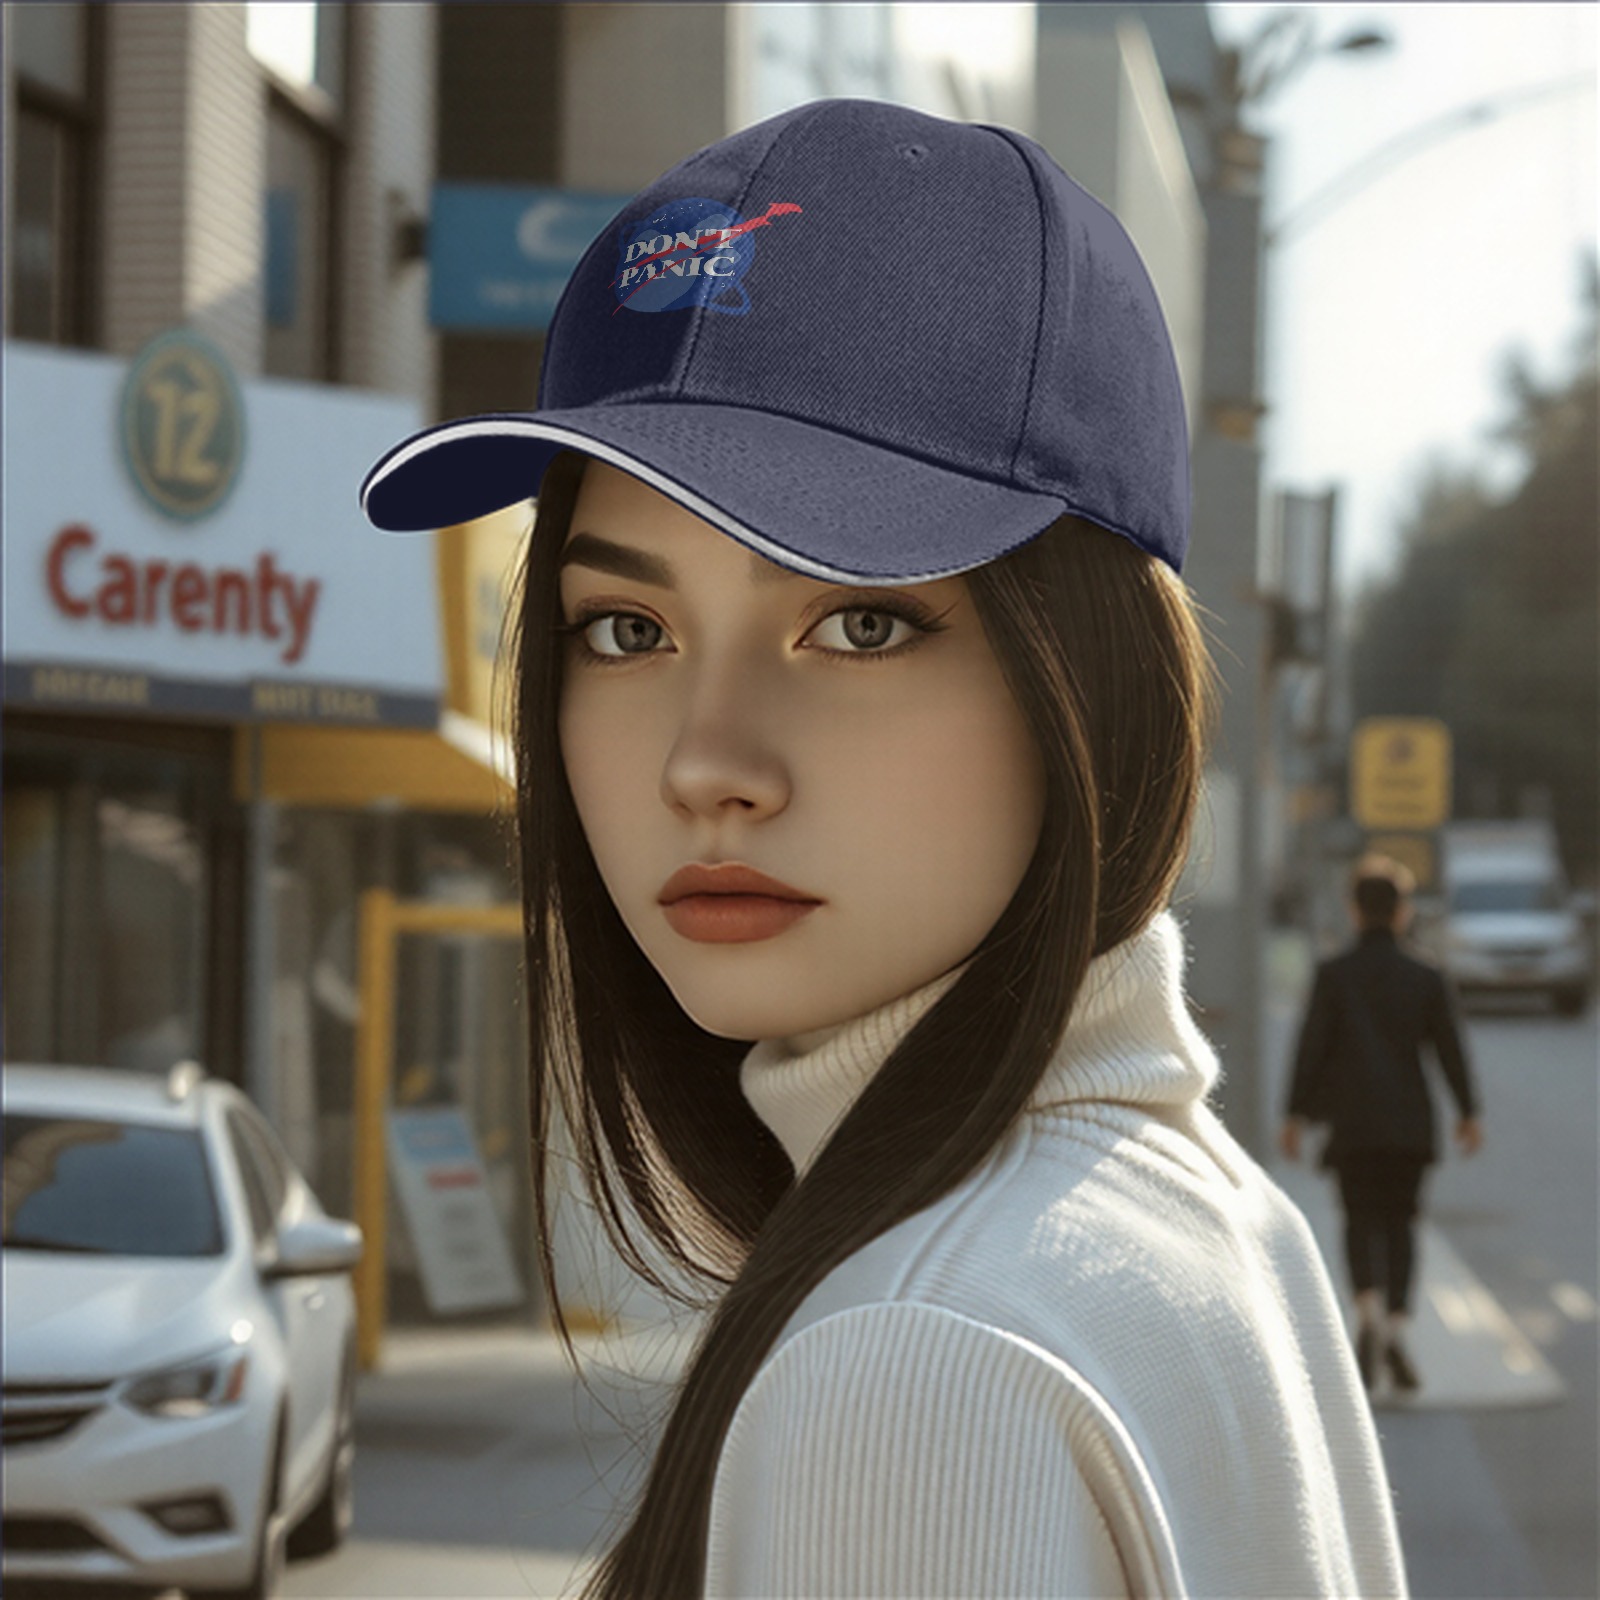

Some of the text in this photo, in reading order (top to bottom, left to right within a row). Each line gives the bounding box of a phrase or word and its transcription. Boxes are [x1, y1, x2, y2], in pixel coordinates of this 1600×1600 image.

[618, 256, 735, 288] PANIC
[623, 228, 742, 263] DON'T
[146, 377, 219, 485] 12
[45, 522, 321, 664] Carenty
